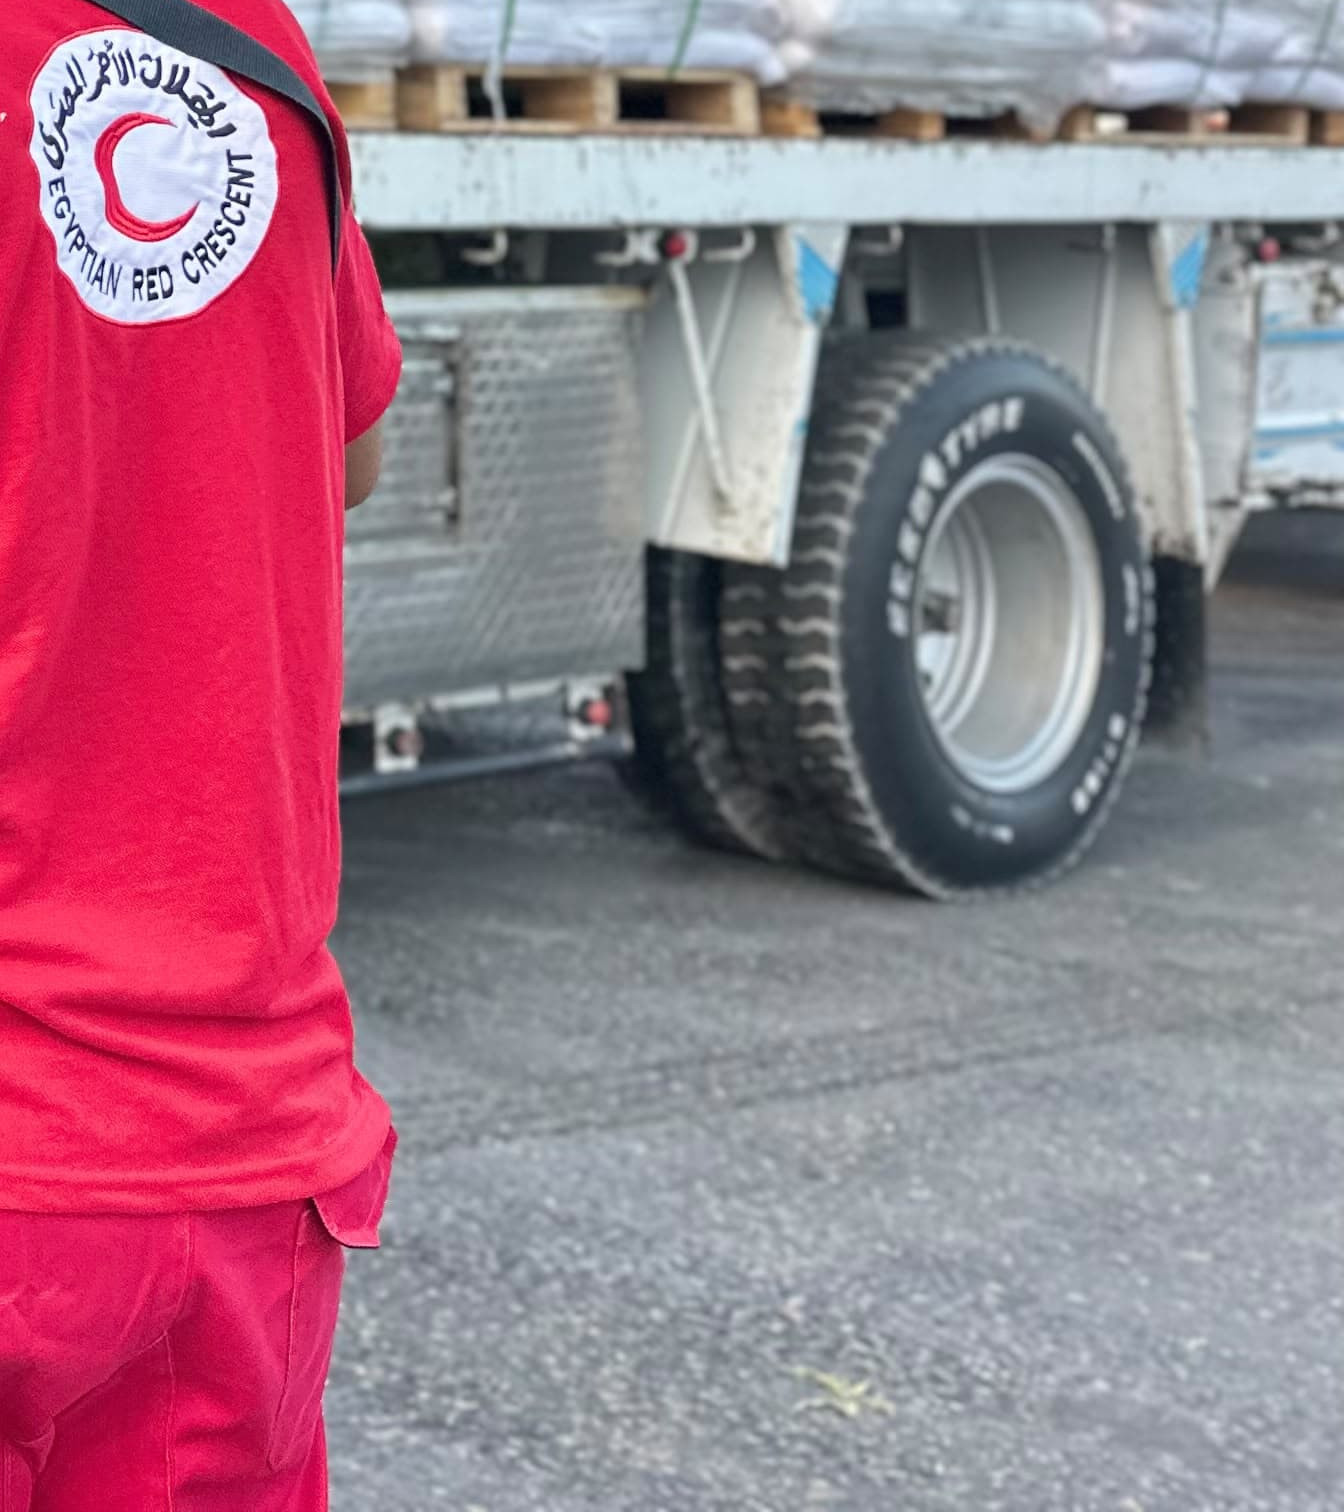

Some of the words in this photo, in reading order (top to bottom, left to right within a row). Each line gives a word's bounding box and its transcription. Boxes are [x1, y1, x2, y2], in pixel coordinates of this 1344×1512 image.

[48, 176, 123, 300] EGYPTIAN
[131, 264, 175, 303] RED
[181, 148, 256, 286] CRESCENT
